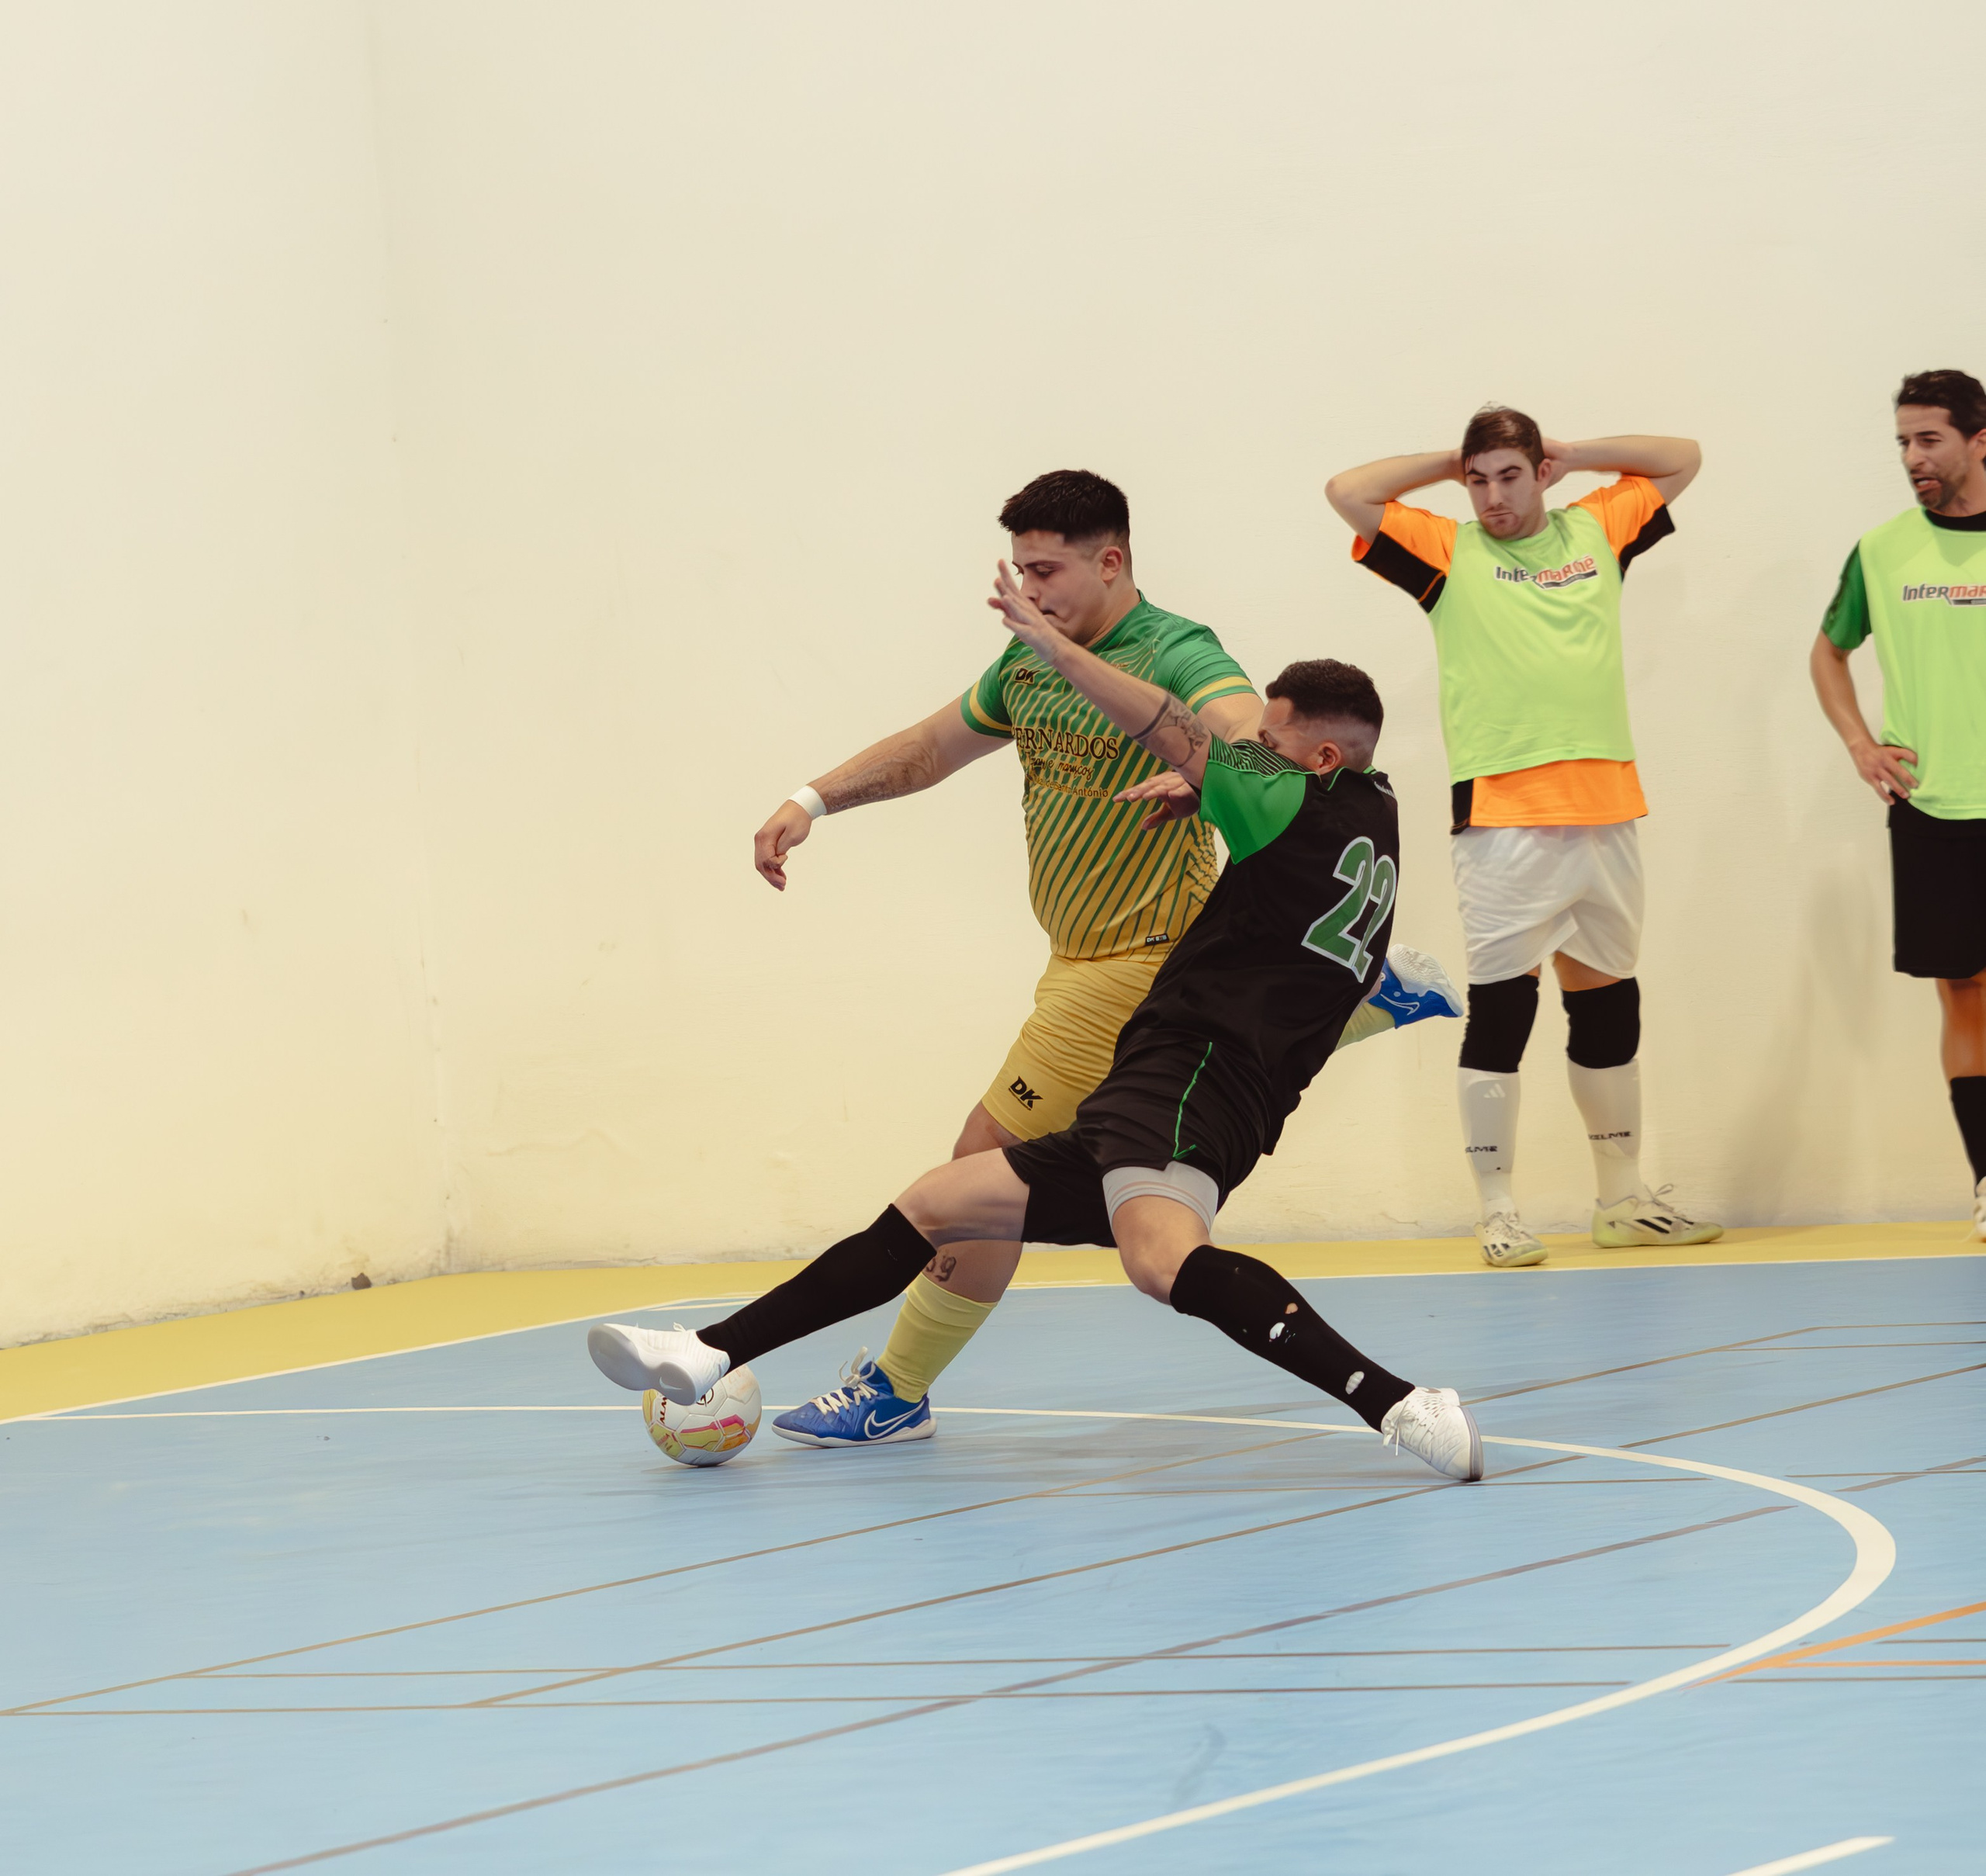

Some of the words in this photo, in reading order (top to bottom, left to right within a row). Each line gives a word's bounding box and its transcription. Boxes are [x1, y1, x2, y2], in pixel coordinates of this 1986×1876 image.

[1014, 667, 1040, 685] DK
[1012, 726, 1119, 760] ERNARDOS
[1071, 785, 1109, 798] António
[1301, 836, 1397, 983] 22
[1009, 1075, 1044, 1110] DK
